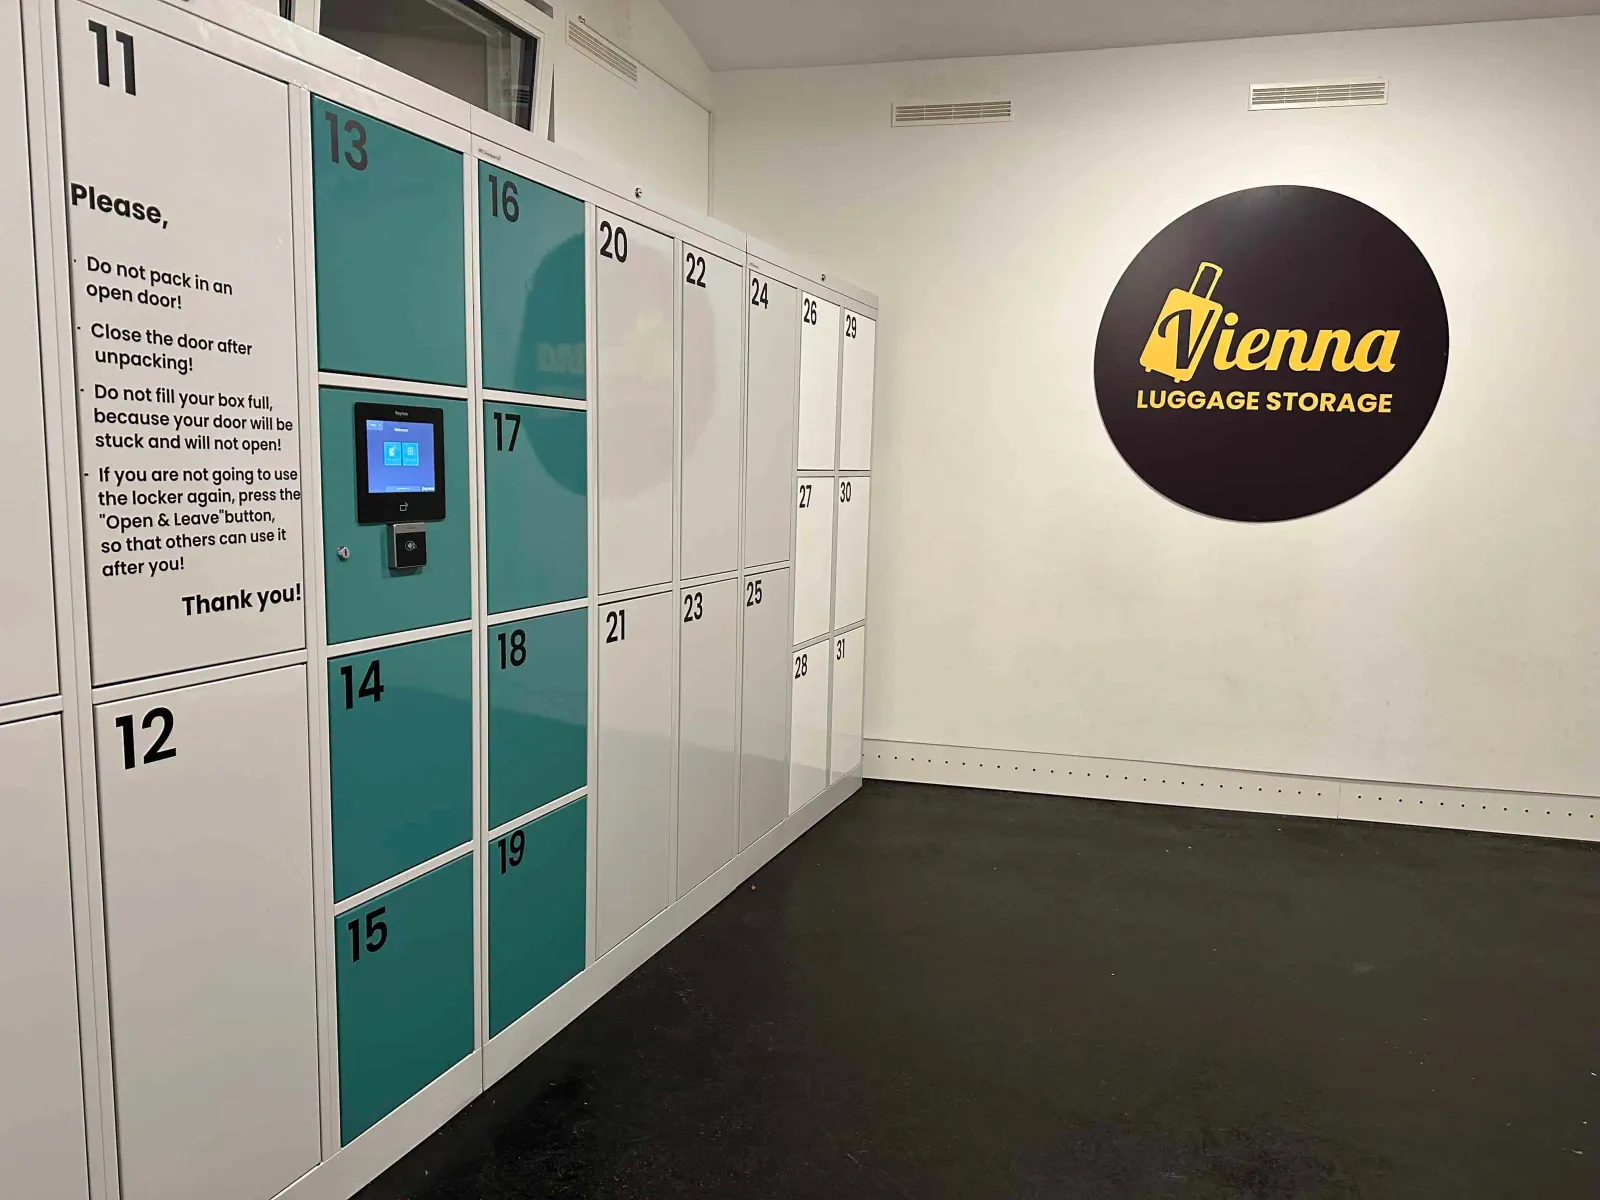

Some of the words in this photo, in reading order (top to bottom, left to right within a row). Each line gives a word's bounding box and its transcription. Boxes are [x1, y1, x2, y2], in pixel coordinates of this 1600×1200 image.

[88, 19, 136, 96] 11
[325, 111, 368, 171] 13
[71, 183, 168, 229] Please,
[489, 174, 519, 223] 16
[600, 221, 627, 263] 20
[87, 256, 112, 274] Do
[117, 264, 146, 280] not
[150, 270, 191, 288] pack
[195, 274, 209, 291] in
[213, 282, 232, 295] an
[686, 252, 706, 288] 22
[86, 284, 133, 303] open
[137, 289, 181, 309] door!
[752, 278, 768, 309] 24
[804, 298, 817, 325] 26
[846, 314, 857, 339] 29
[91, 323, 141, 342] Close
[146, 329, 173, 346] the
[177, 333, 214, 351] door
[217, 339, 252, 355] after
[1157, 309, 1400, 373] Vienna
[95, 350, 193, 375] unpacking!
[95, 384, 118, 400] Do
[123, 388, 152, 402] not
[155, 387, 175, 403] fill
[179, 393, 214, 409] your
[218, 393, 245, 408] box
[248, 394, 273, 412] full,
[1137, 390, 1260, 410] LUGGAGE
[1266, 392, 1393, 413] STORAGE
[94, 407, 170, 426] because
[173, 415, 209, 431] your
[213, 414, 247, 429] door
[250, 416, 273, 430] will
[276, 417, 293, 431] be
[494, 412, 521, 452] 17
[95, 433, 144, 448] stuck
[148, 435, 180, 449] and
[184, 435, 210, 449] will
[214, 437, 239, 450] not
[242, 438, 281, 455] open!
[99, 466, 110, 482] If
[114, 470, 147, 487] you
[151, 470, 179, 482] are
[183, 468, 209, 481] not
[212, 467, 254, 486] going
[257, 468, 271, 481] to
[274, 470, 298, 480] use
[840, 481, 851, 503] 30
[98, 491, 128, 506] the
[132, 490, 183, 505] locker
[187, 488, 235, 508] again,
[239, 491, 276, 506] press
[280, 488, 301, 500] the
[799, 485, 812, 508] 27
[99, 513, 153, 534] "Open
[158, 513, 170, 527] &
[101, 541, 122, 553] so
[126, 536, 162, 551] that
[166, 534, 216, 549] others
[219, 533, 246, 545] can
[250, 532, 275, 543] use
[278, 528, 286, 541] it
[102, 560, 144, 577] after
[148, 556, 184, 577] you!
[182, 589, 253, 616] Thank
[257, 583, 301, 612] you!
[684, 592, 703, 623] 23
[746, 579, 762, 607] 25
[606, 609, 625, 643] 21
[498, 629, 526, 670] 18
[836, 638, 845, 660] 31
[795, 654, 807, 679] 28
[340, 660, 384, 710] 14
[115, 707, 176, 770] 12
[497, 829, 526, 875] 19
[347, 907, 389, 962] 15
